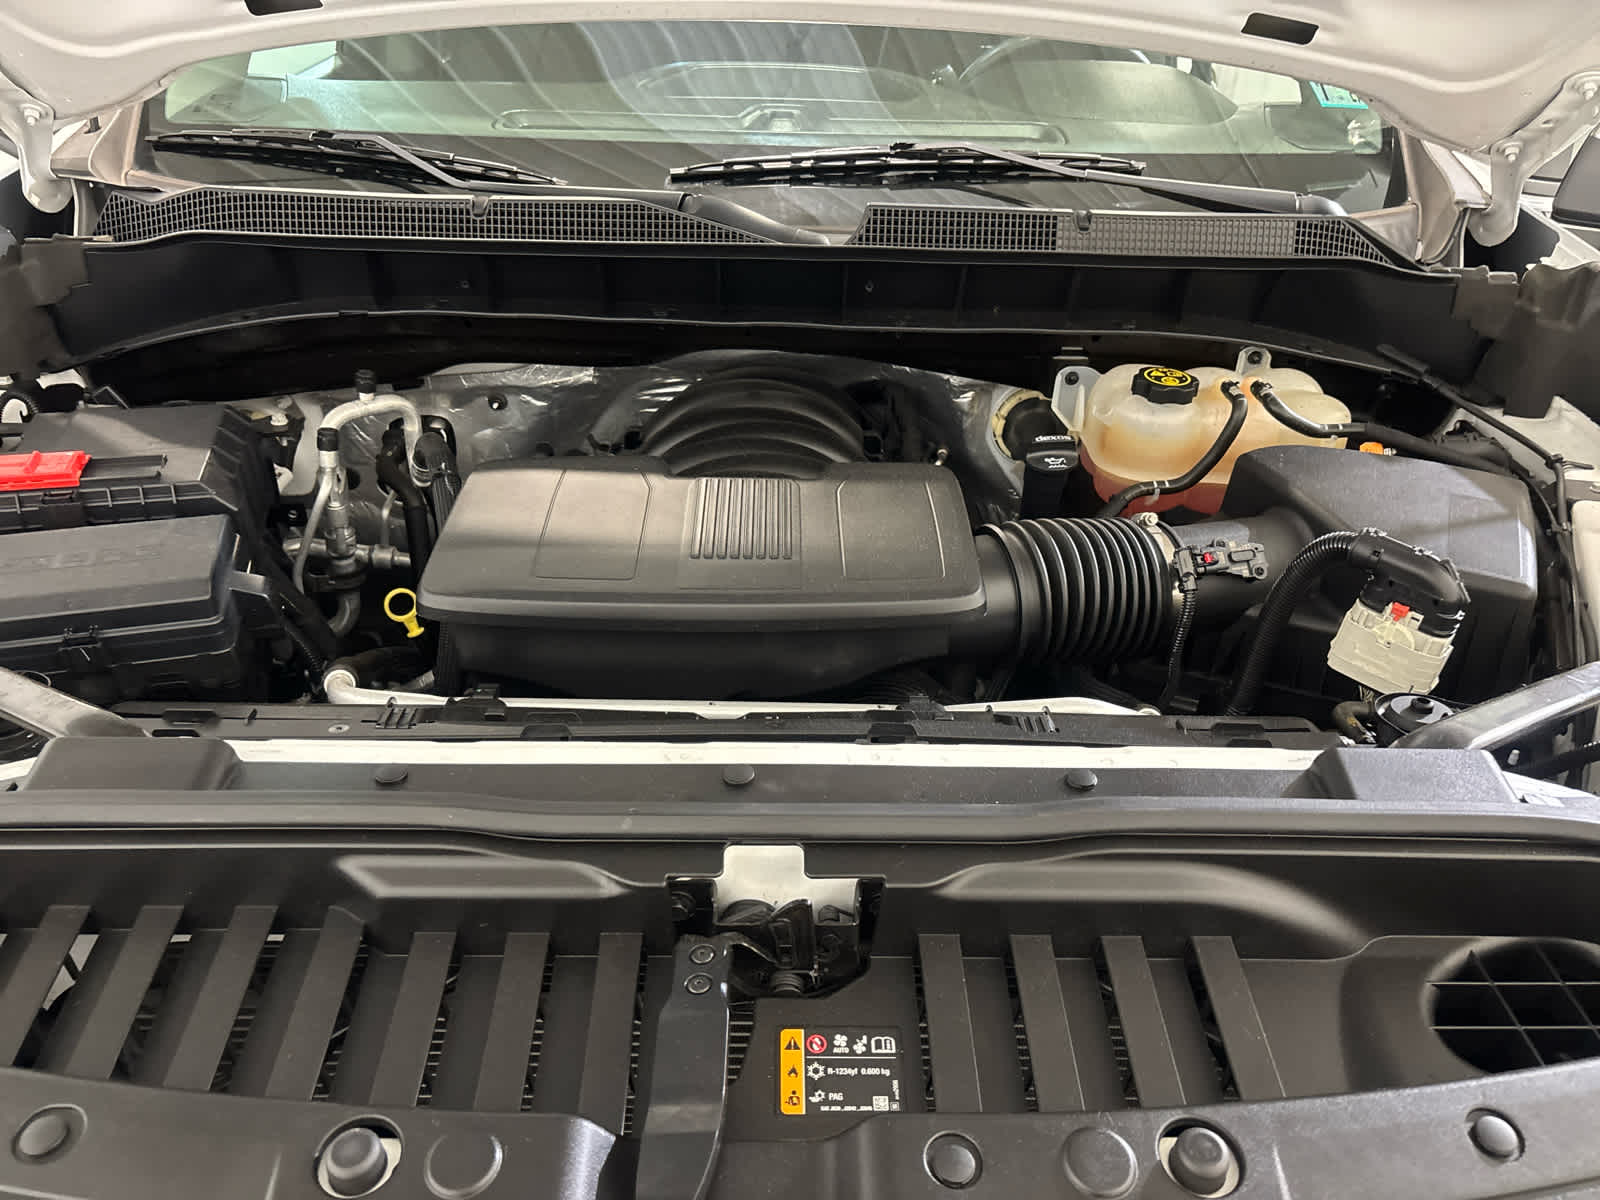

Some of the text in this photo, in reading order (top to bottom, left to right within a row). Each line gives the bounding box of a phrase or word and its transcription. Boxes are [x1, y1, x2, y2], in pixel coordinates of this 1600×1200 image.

[827, 1067, 891, 1077] R-1234yf 0.600 kg
[828, 1092, 844, 1101] PAG
